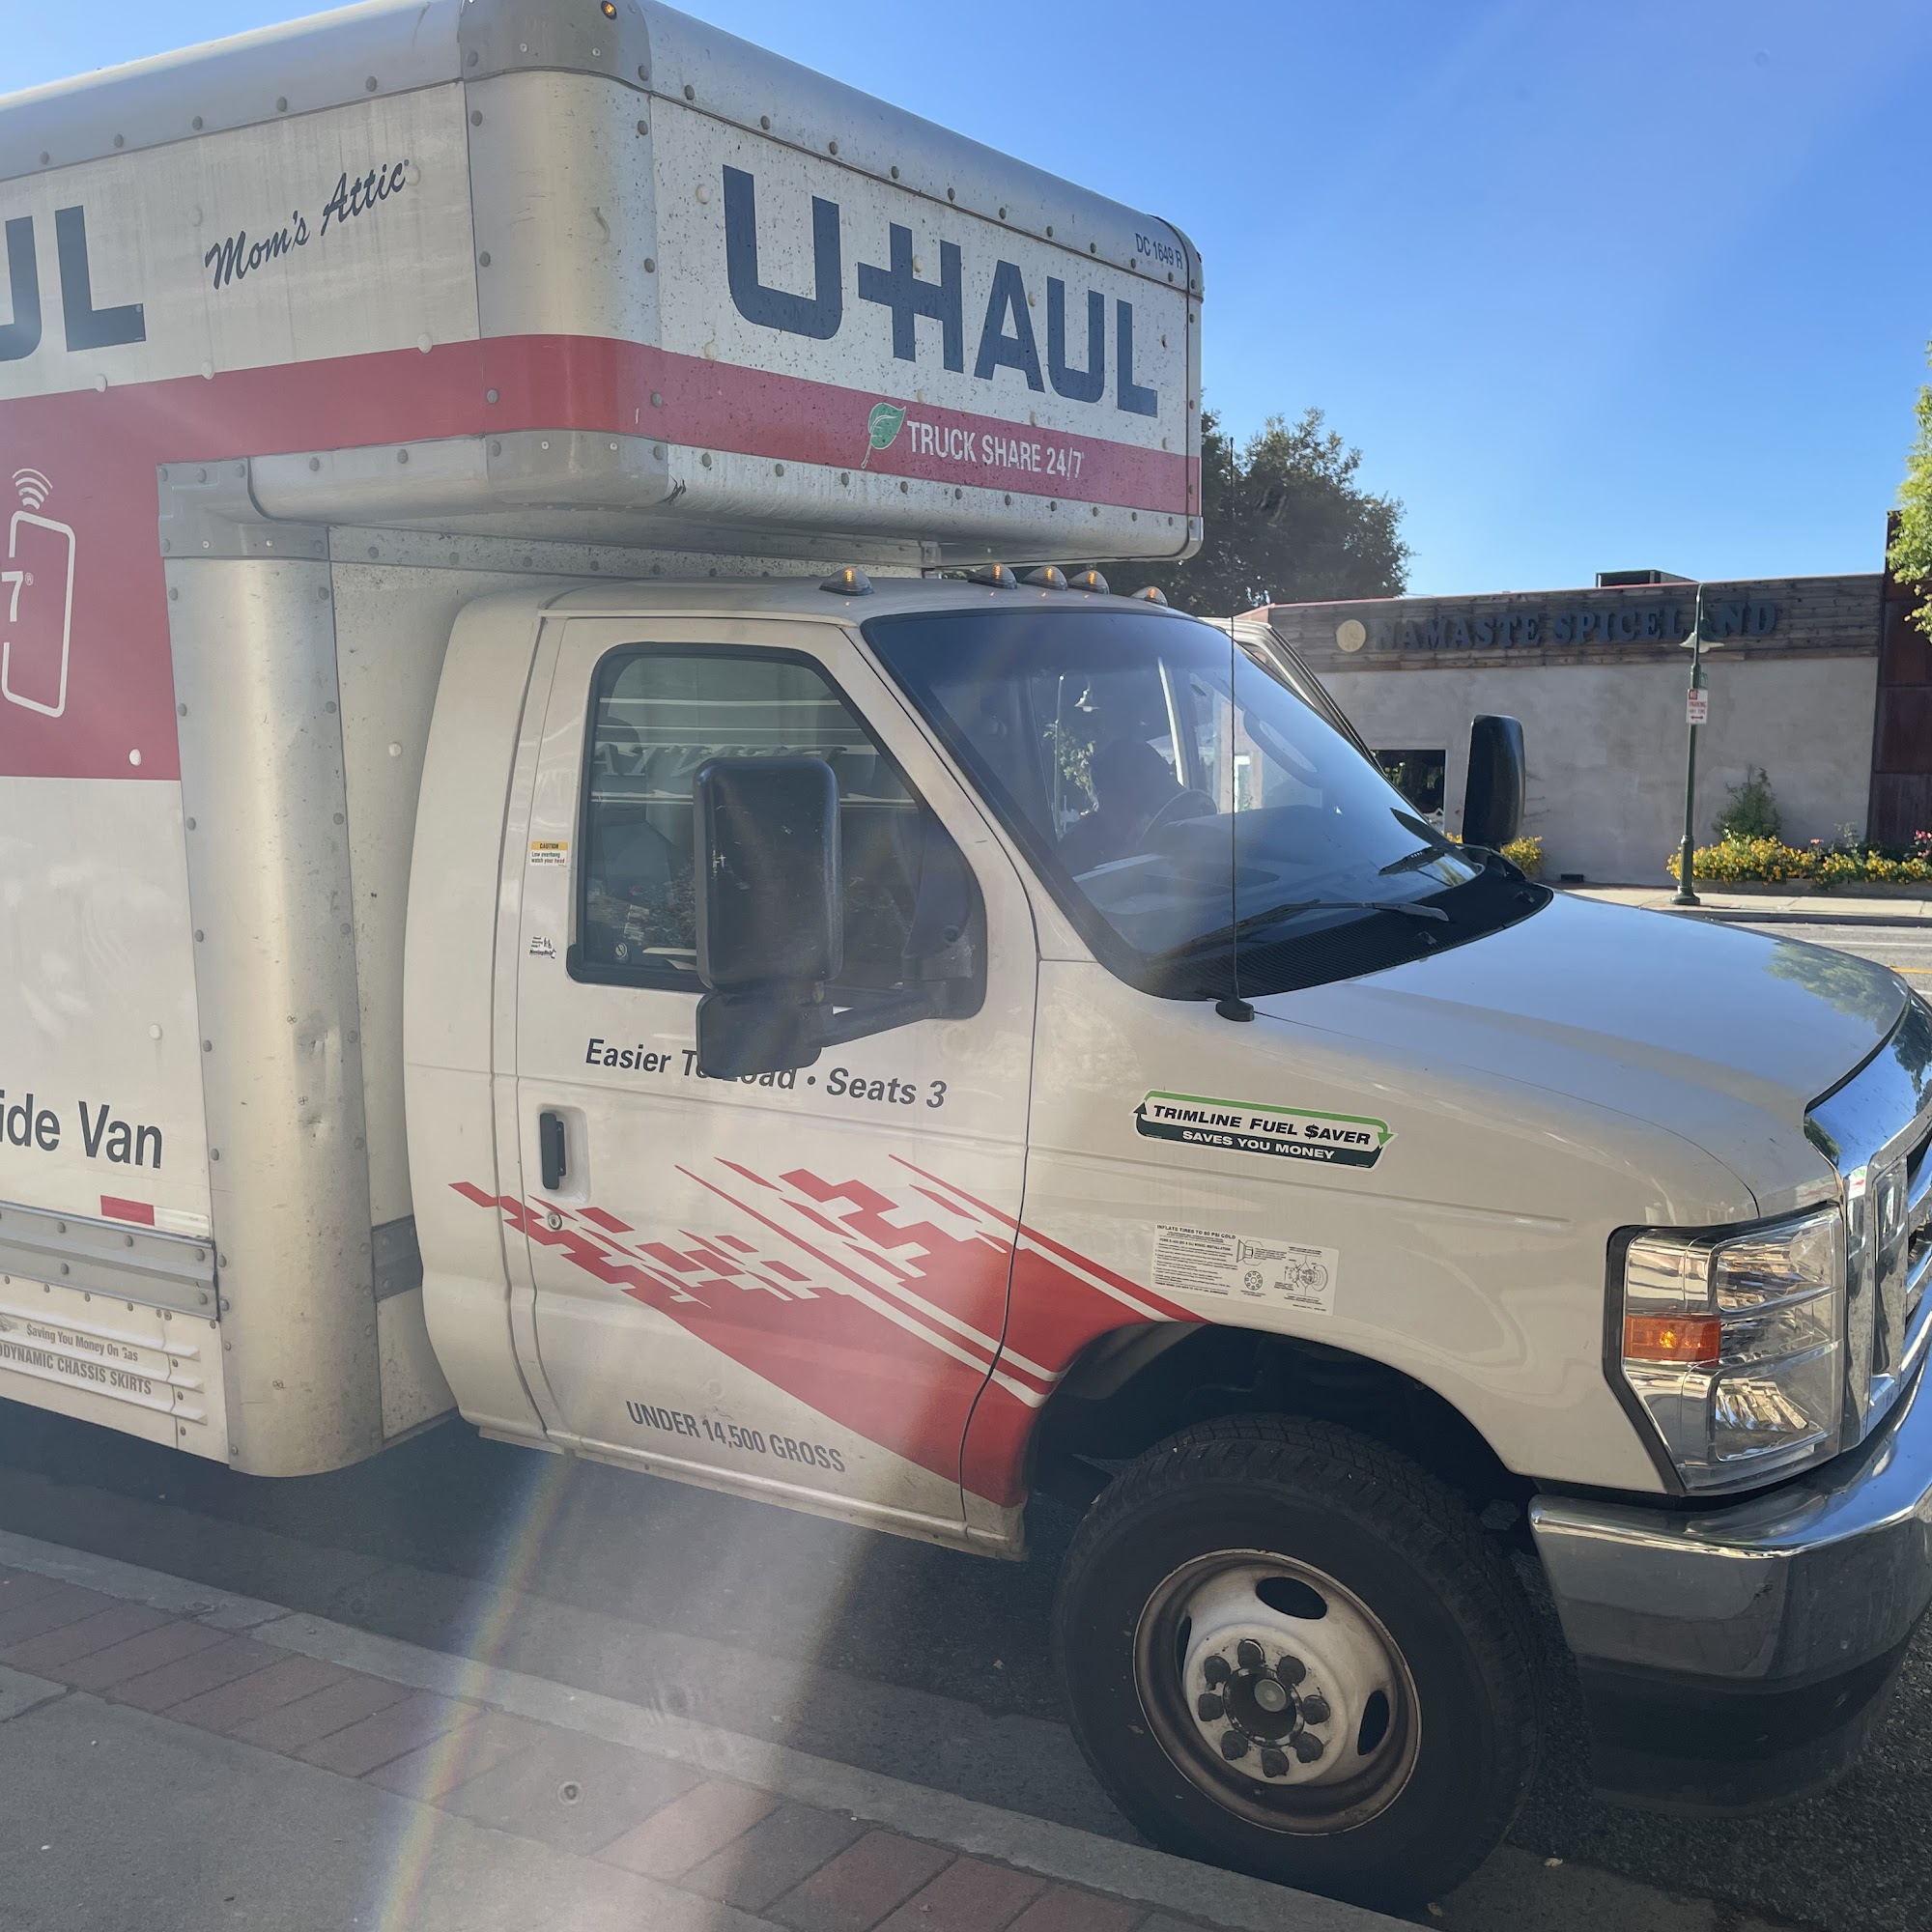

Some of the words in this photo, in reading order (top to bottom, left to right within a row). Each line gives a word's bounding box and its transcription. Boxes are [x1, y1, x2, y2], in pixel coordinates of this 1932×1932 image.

[205, 211, 310, 289] Mom's
[1135, 233, 1151, 256] DC
[1153, 242, 1175, 266] 1649
[1175, 249, 1183, 270] R
[723, 164, 1158, 418] U-HAUL
[907, 420, 977, 462] TRUCK
[981, 435, 1041, 472] SHARE
[1374, 611, 1541, 651] NAMASTE
[585, 1038, 671, 1073] Easier
[827, 1067, 917, 1105] Seats
[925, 1080, 947, 1108] 3
[78, 1100, 162, 1169] Van
[1154, 1105, 1242, 1128] TRIMLINE
[1249, 1118, 1297, 1136] FUEL
[1304, 1123, 1371, 1150] $AVER
[1182, 1130, 1233, 1146] SAVES
[1237, 1138, 1270, 1151] YOU
[1275, 1144, 1335, 1159] MONEY
[57, 1331, 73, 1346] You
[75, 1336, 104, 1356] Money
[107, 1344, 119, 1357] On
[57, 1357, 106, 1383] CHASSIS
[110, 1371, 152, 1395] SKIRTS
[626, 1402, 701, 1438] UNDER
[702, 1419, 766, 1453] 14,500
[770, 1434, 845, 1472] GROSS
